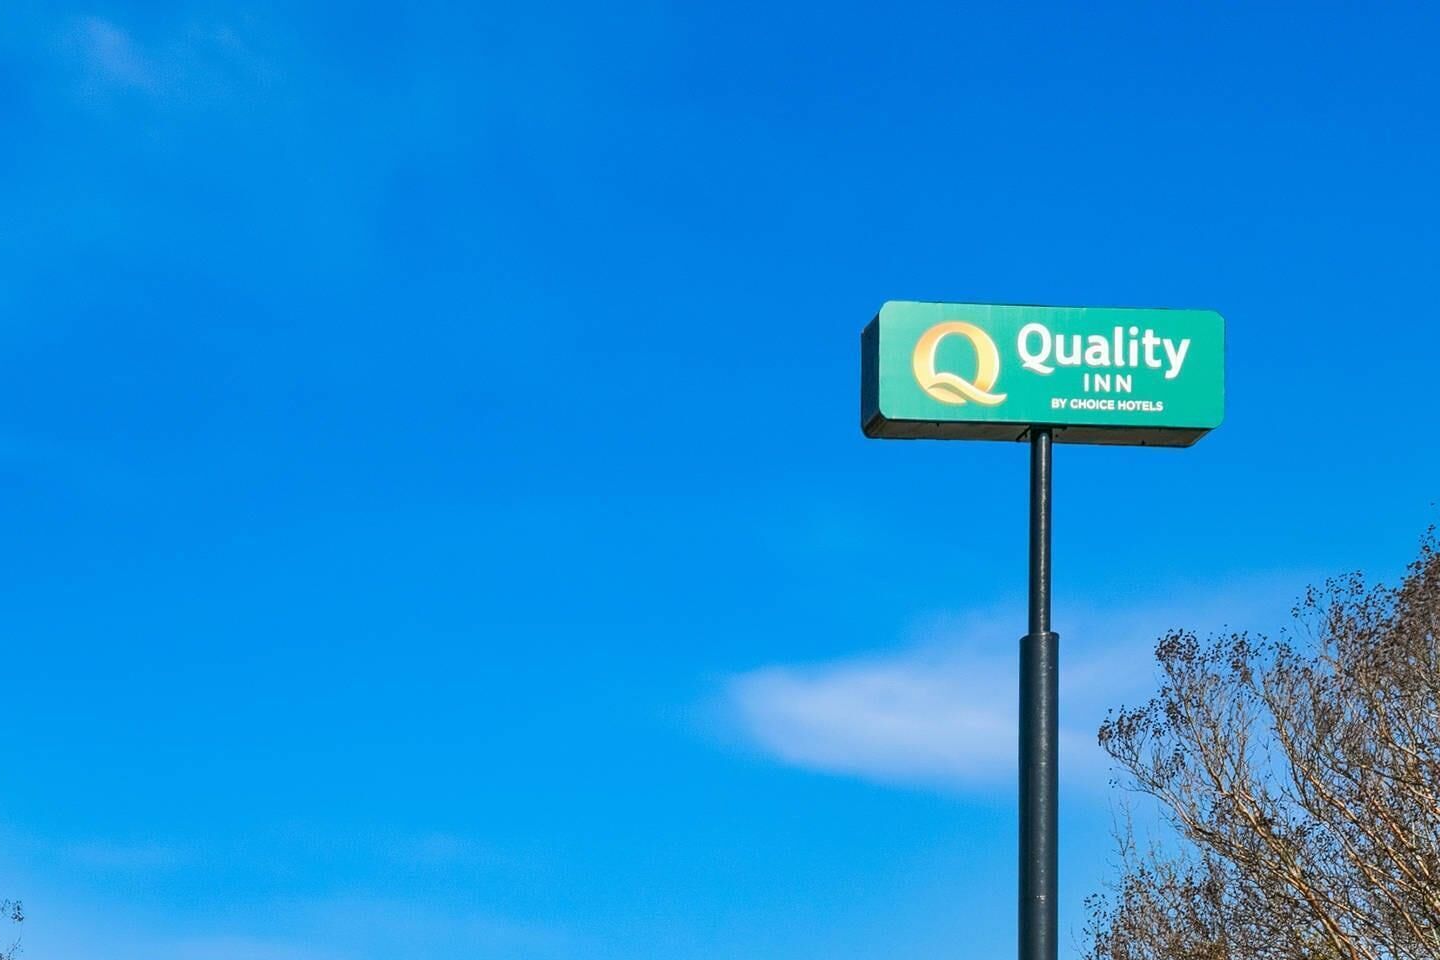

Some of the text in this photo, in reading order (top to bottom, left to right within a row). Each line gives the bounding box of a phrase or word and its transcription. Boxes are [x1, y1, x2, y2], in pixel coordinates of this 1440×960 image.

[912, 321, 1008, 405] Q
[1017, 322, 1191, 379] Quality
[1083, 372, 1133, 393] INN
[1051, 397, 1164, 412] BY CHOICE HOTELS
